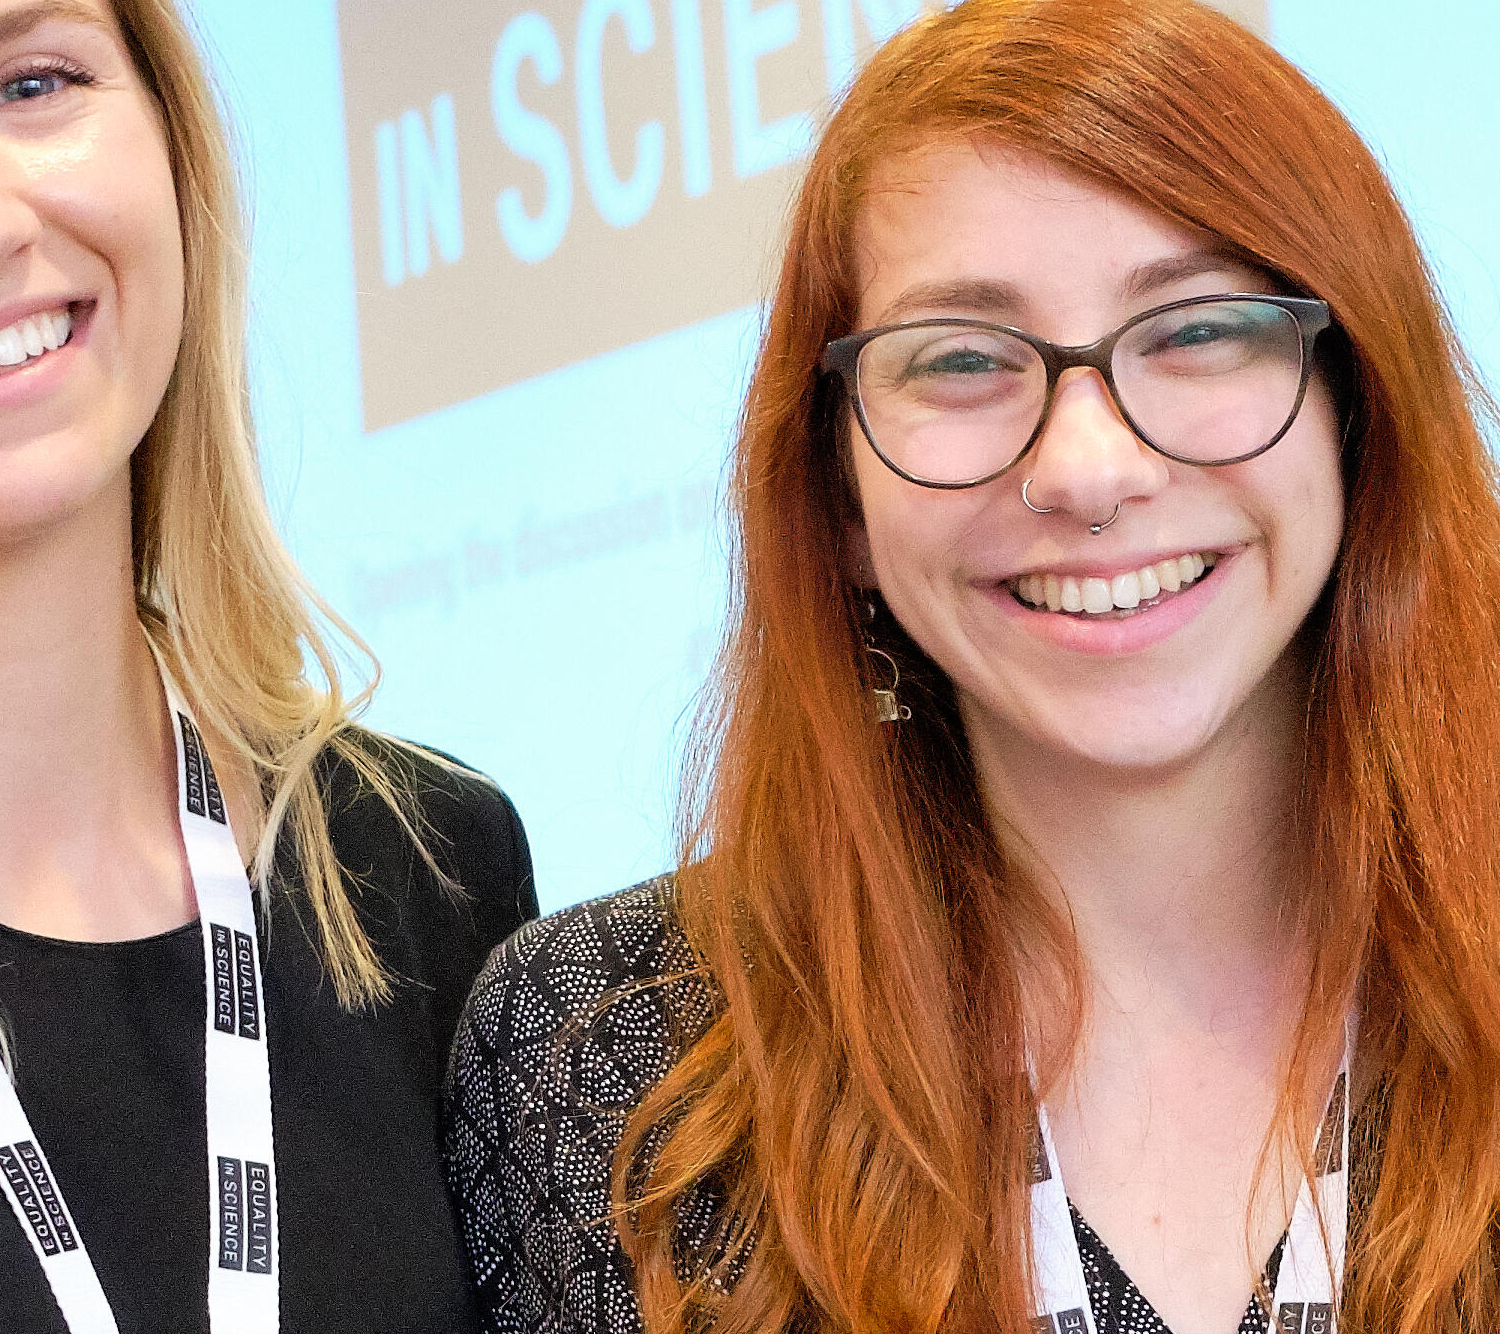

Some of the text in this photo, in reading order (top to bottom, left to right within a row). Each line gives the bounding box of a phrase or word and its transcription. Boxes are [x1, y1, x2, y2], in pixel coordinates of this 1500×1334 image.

[375, 90, 463, 287] IN
[216, 929, 231, 1026] IN SCIENCE
[239, 937, 255, 1034] EQUALITY
[21, 1147, 72, 1245] IN SCIENCE
[223, 1162, 238, 1262] IN SCIENCE
[251, 1167, 266, 1267] EQUALITY
